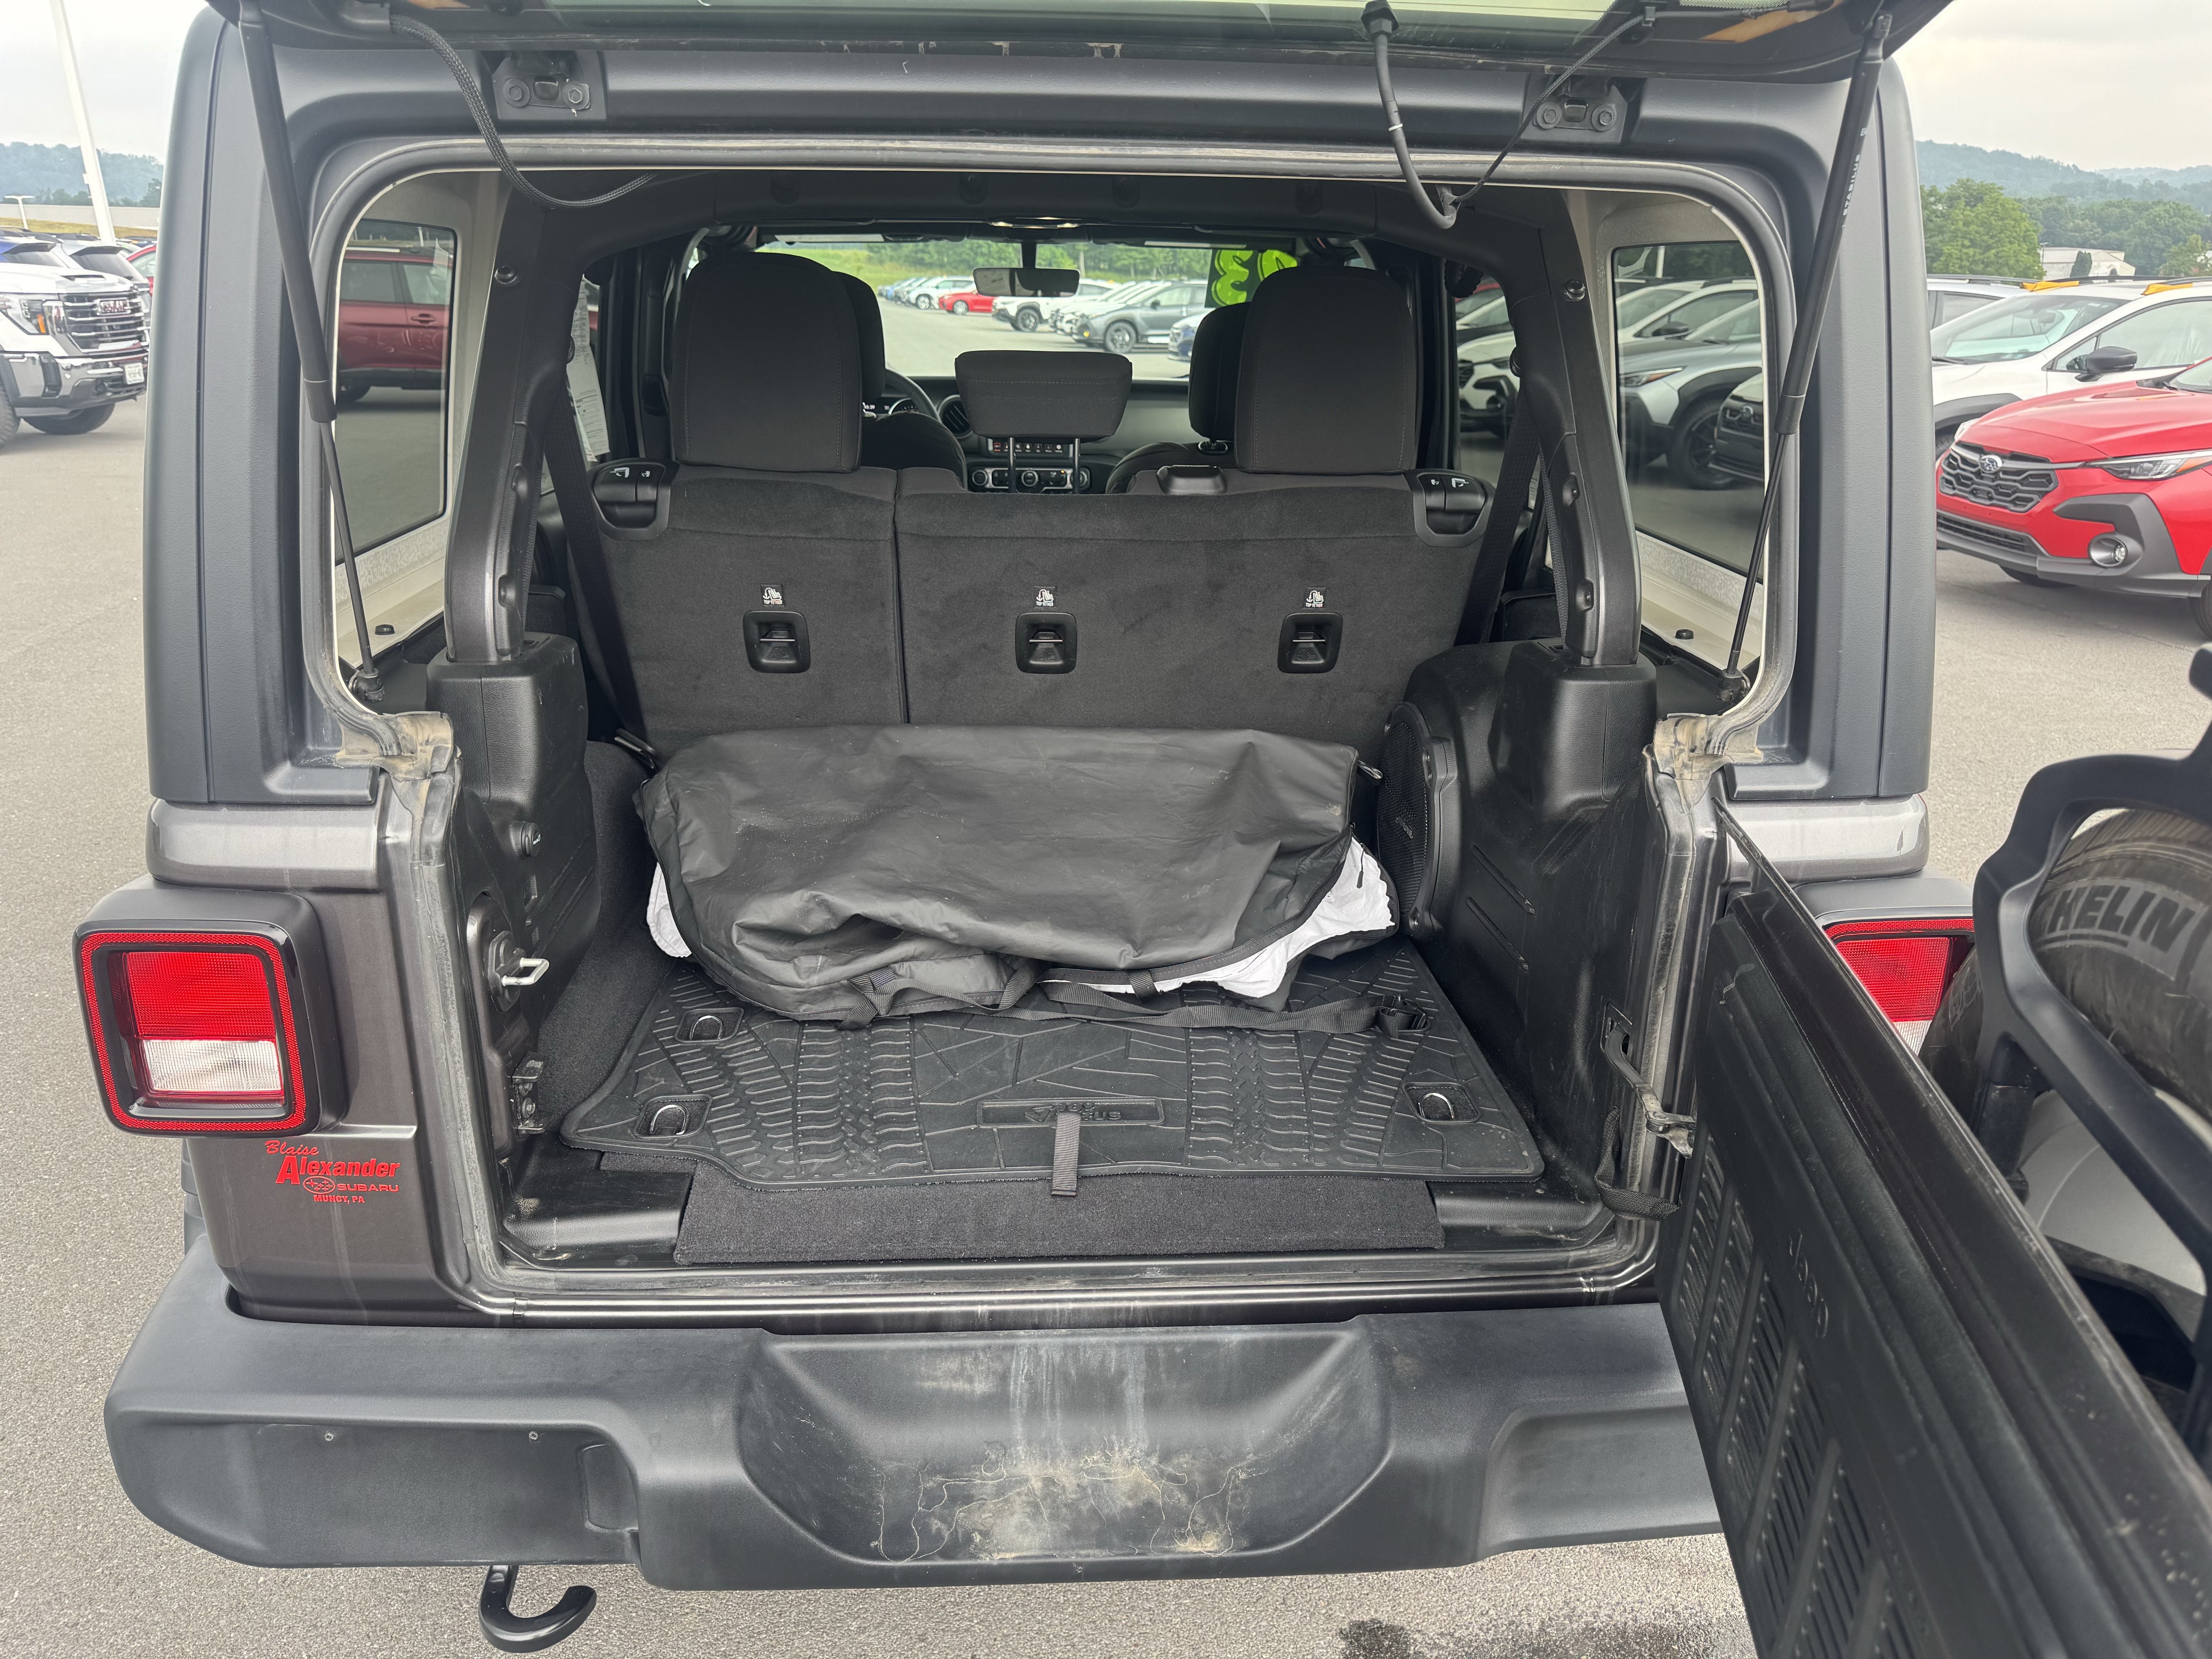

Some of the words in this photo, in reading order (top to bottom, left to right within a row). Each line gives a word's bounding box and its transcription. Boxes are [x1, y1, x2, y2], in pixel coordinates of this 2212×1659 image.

[265, 1140, 319, 1156] Blaise
[275, 1155, 400, 1184] Alexander
[313, 1195, 350, 1204] MUNCY,
